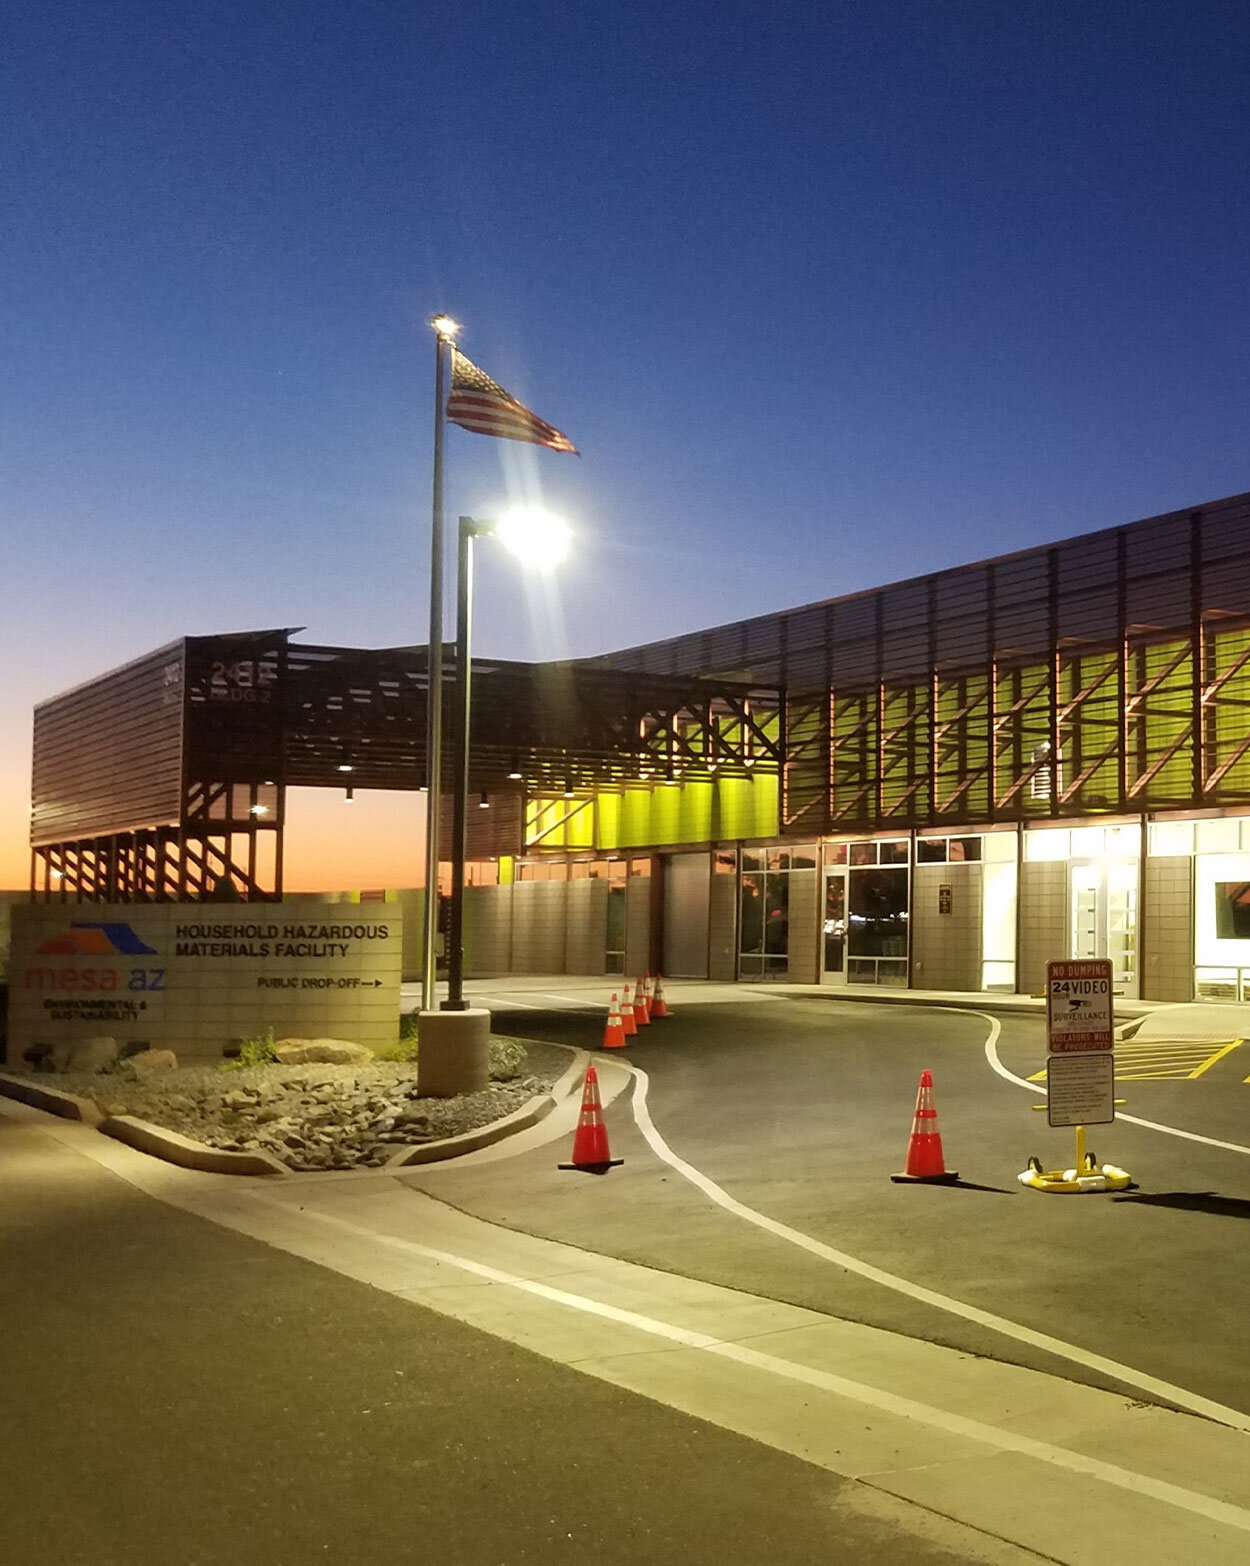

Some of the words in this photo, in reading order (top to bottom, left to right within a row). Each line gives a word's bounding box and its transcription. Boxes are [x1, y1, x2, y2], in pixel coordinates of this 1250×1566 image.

[176, 925, 278, 939] HOUSEHOLD
[284, 925, 388, 939] HAZARDOUS
[176, 943, 269, 957] MATERIALS
[275, 943, 348, 957] FACILITY
[1053, 965, 1065, 977] NO
[1068, 964, 1107, 977] DUMPING
[24, 968, 117, 991] mesa
[128, 967, 167, 991] az
[257, 977, 298, 988] PUBLIC
[302, 976, 360, 988] DROP-OFF
[1053, 982, 1070, 992] 24
[1071, 980, 1108, 994] VIDEO
[1053, 1011, 1107, 1021] SURVEILLANCE
